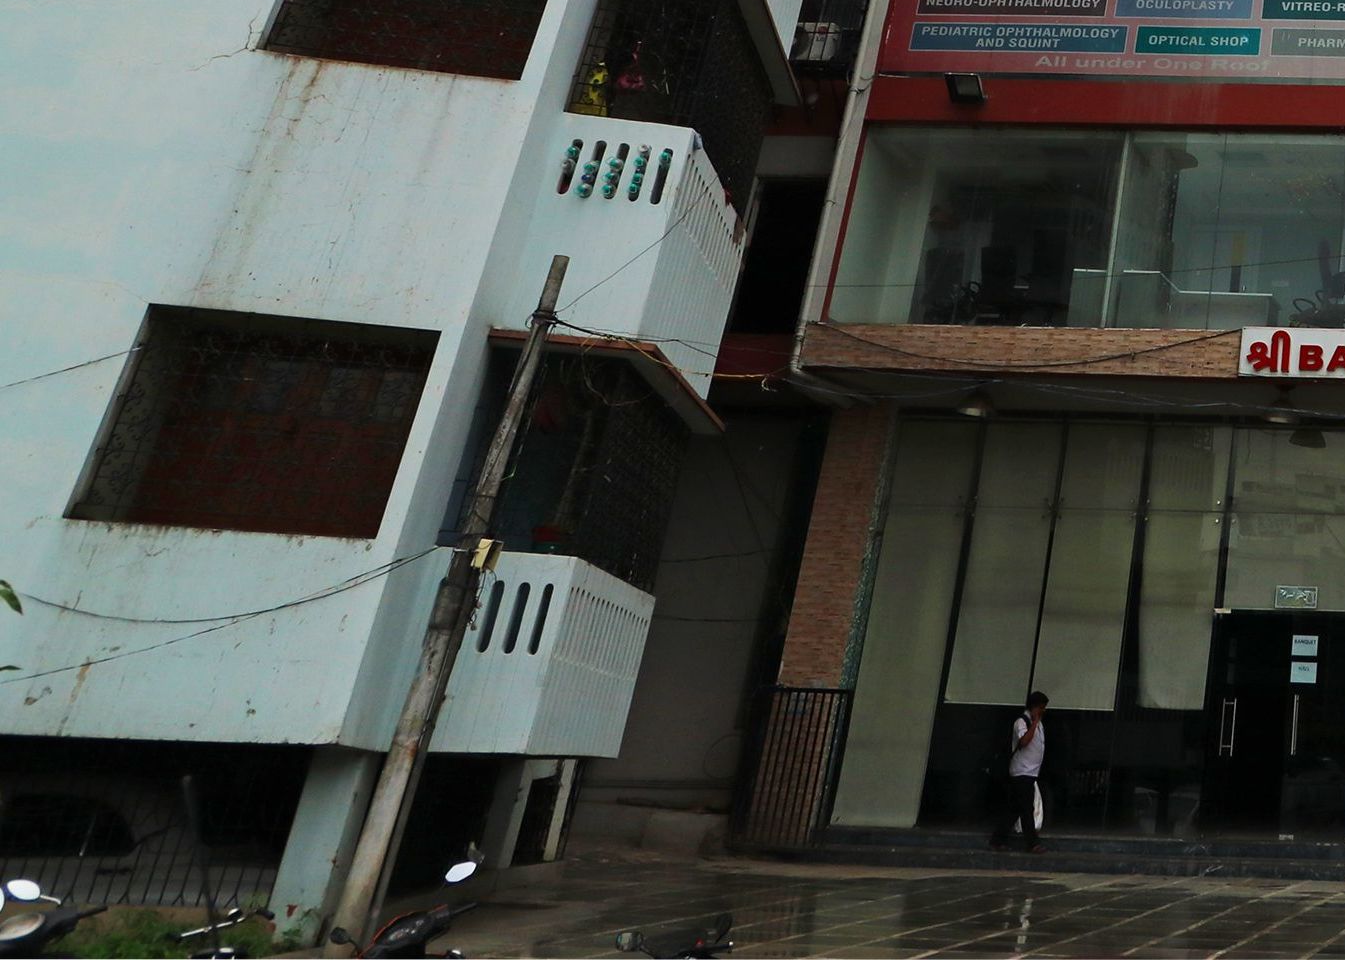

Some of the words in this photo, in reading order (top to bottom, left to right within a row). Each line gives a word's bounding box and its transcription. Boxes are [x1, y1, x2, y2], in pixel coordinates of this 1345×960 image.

[921, 26, 992, 37] PEDIATRIC
[996, 26, 1120, 39] OPHTHALMOLOGY
[975, 38, 1004, 48] AND
[1008, 38, 1061, 49] SQUINT
[1148, 35, 1206, 47] OPTICAL
[1210, 35, 1249, 47] SHOP
[1035, 54, 1068, 68] All
[1075, 55, 1147, 69] under
[1154, 57, 1201, 71] One
[1209, 58, 1272, 71] Roof
[1246, 329, 1292, 373] श्री
